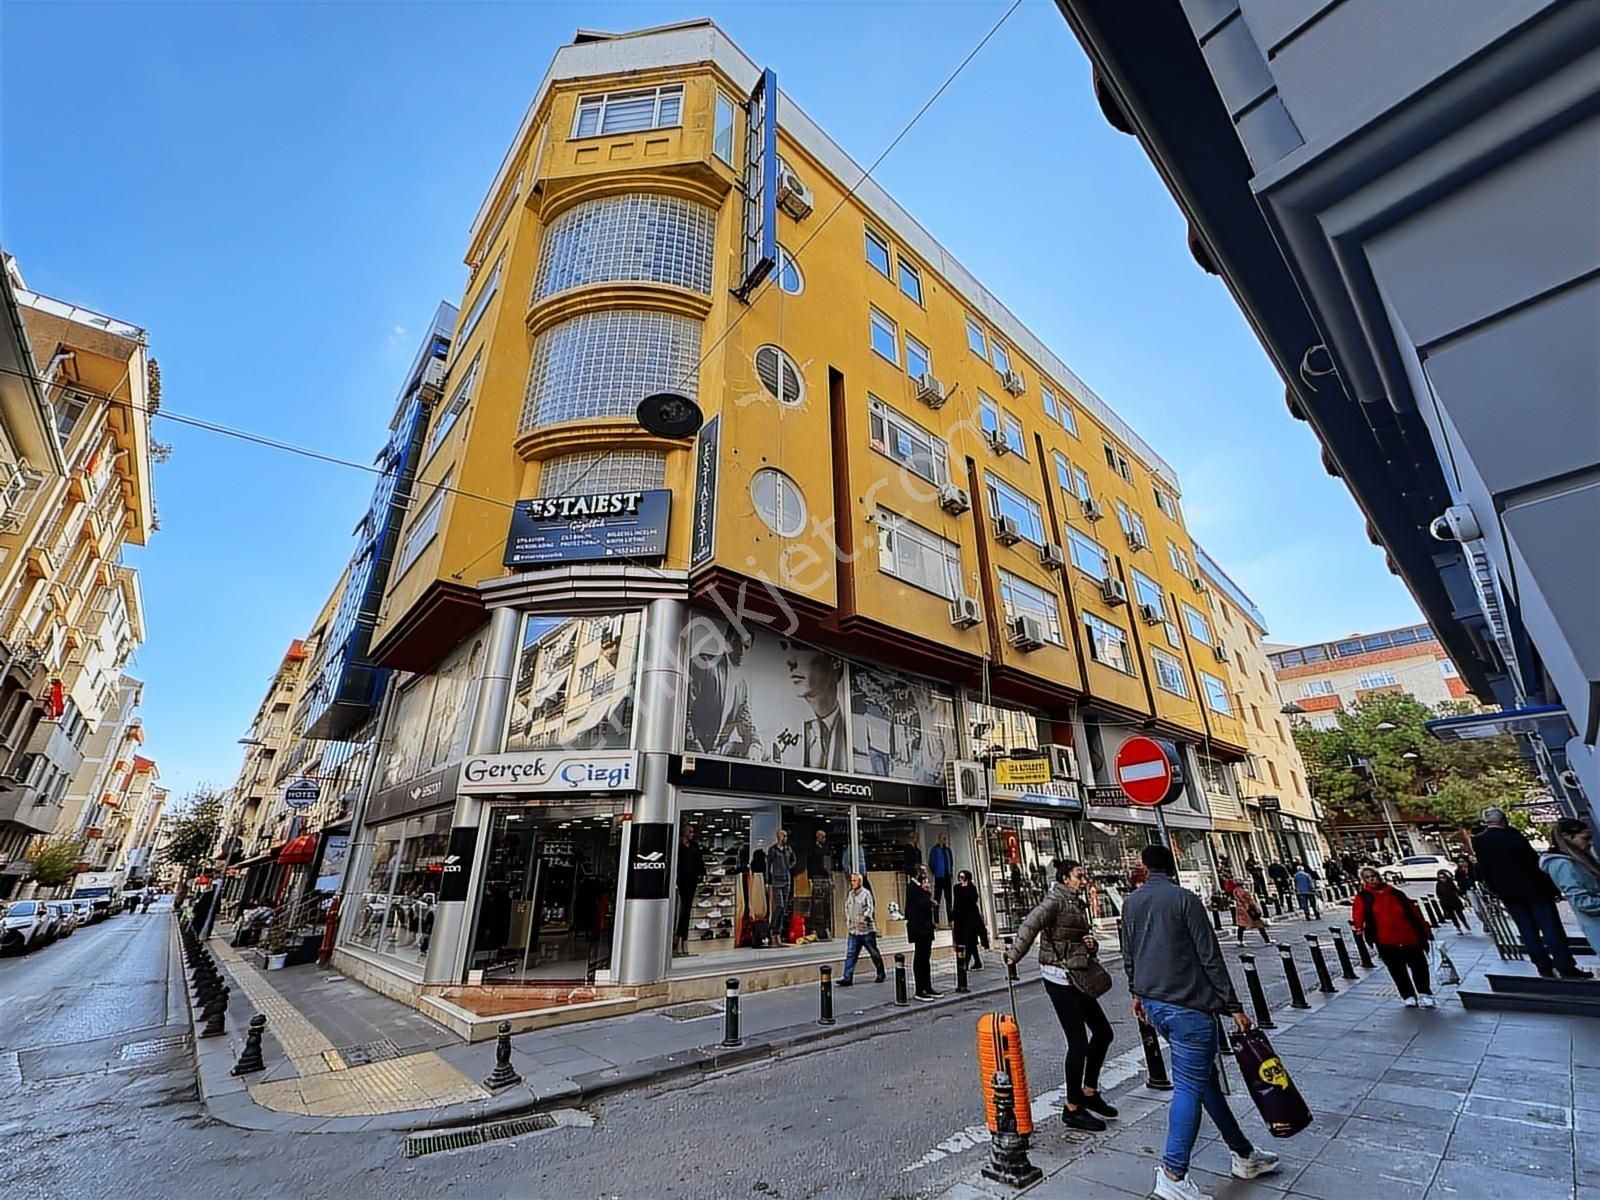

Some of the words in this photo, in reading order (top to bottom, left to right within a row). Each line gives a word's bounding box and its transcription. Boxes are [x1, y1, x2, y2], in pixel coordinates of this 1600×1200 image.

[464, 758, 546, 782] Gerçek
[561, 762, 631, 787] Çizgi
[288, 790, 316, 799] HOTEL
